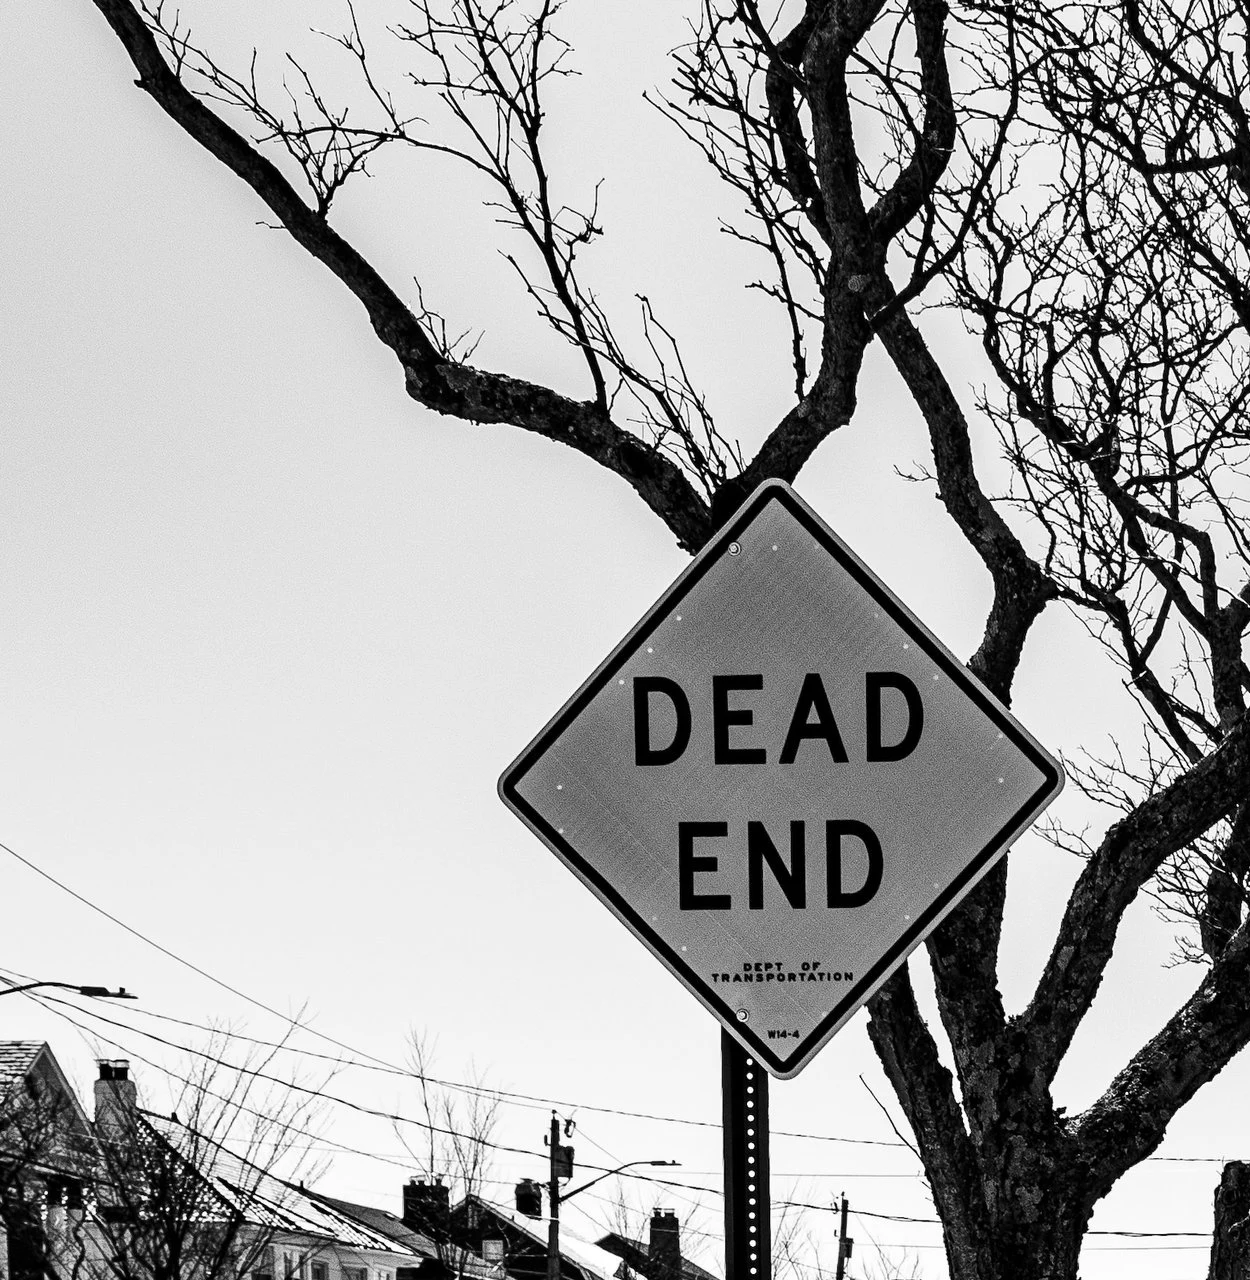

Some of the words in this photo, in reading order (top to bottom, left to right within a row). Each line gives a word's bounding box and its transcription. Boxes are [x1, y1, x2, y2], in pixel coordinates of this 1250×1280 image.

[632, 671, 925, 767] DEAD
[678, 819, 884, 911] END
[743, 962, 783, 972] DEPT
[801, 961, 821, 971] OF
[711, 972, 854, 983] TRANSPORTATION
[767, 1029, 800, 1039] W14-4
